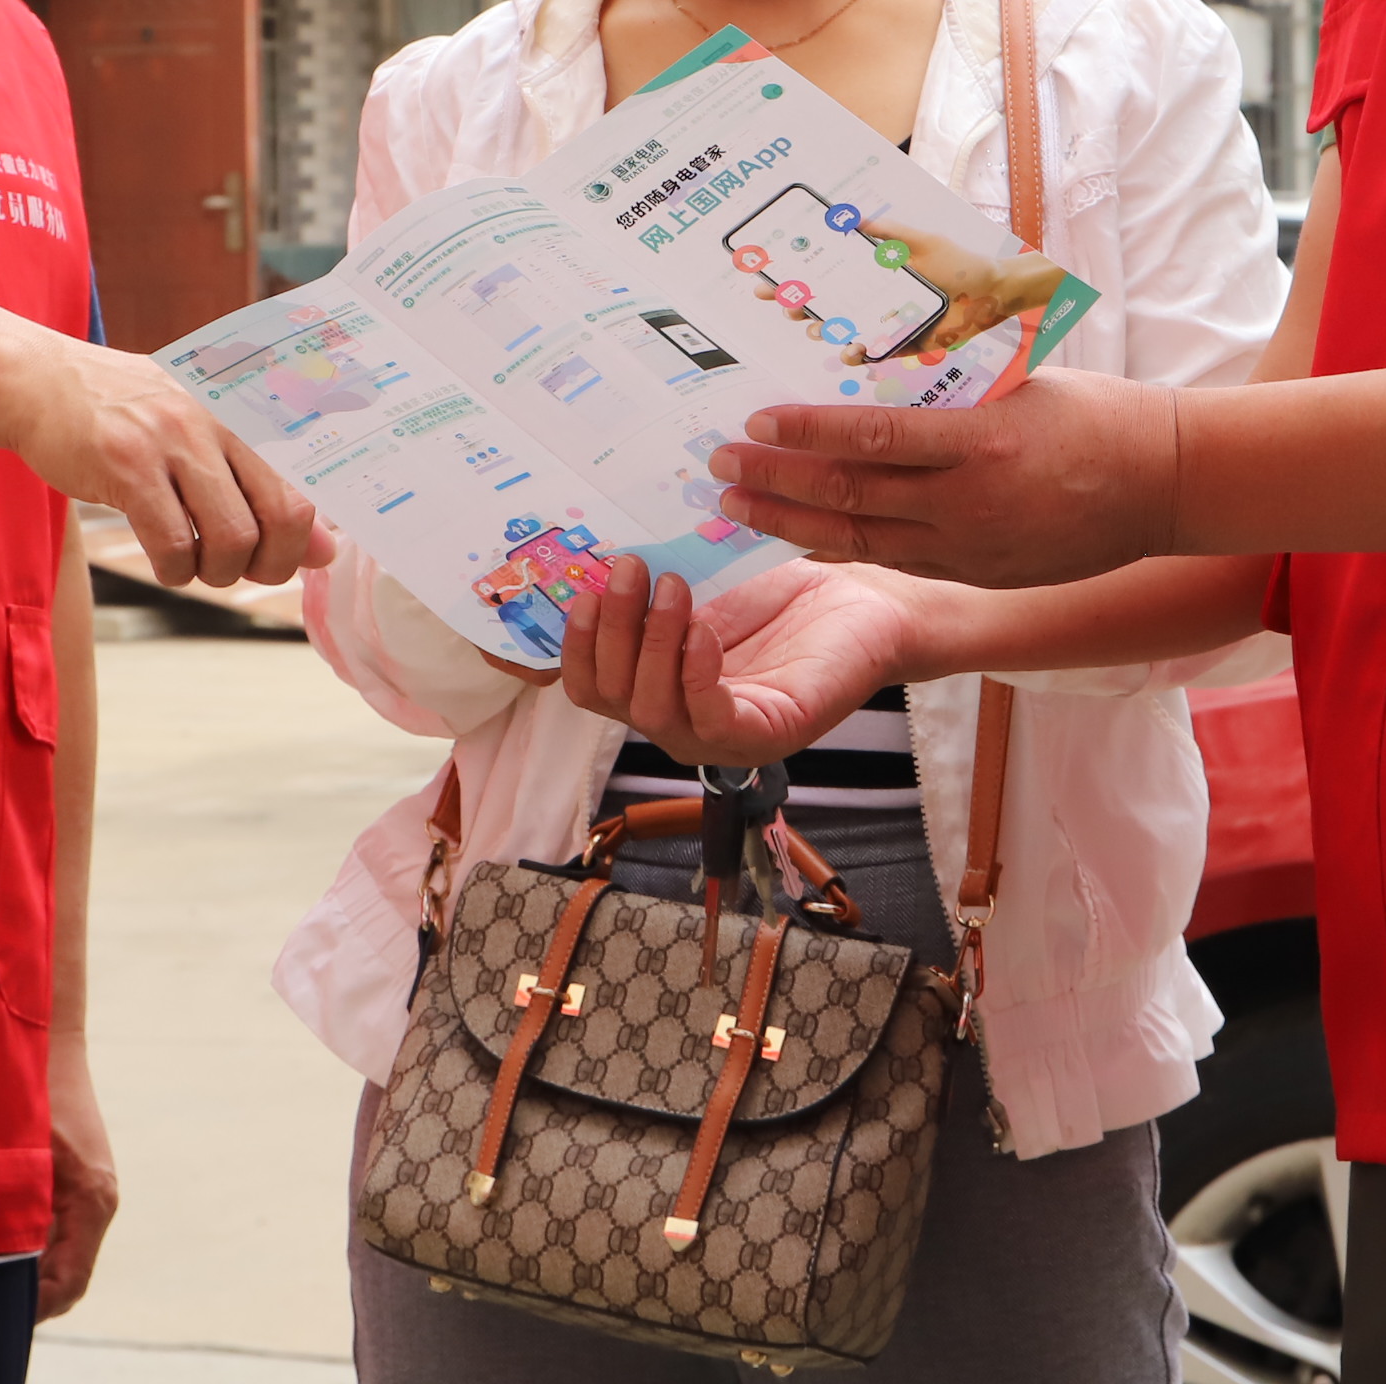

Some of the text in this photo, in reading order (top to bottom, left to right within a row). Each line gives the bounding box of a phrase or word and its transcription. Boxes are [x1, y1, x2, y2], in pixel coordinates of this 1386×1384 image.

[611, 139, 663, 179] 国家电网
[616, 144, 727, 230] 您的随身电管家
[621, 148, 669, 184] STATE GRID
[637, 136, 793, 254] 网上国网App
